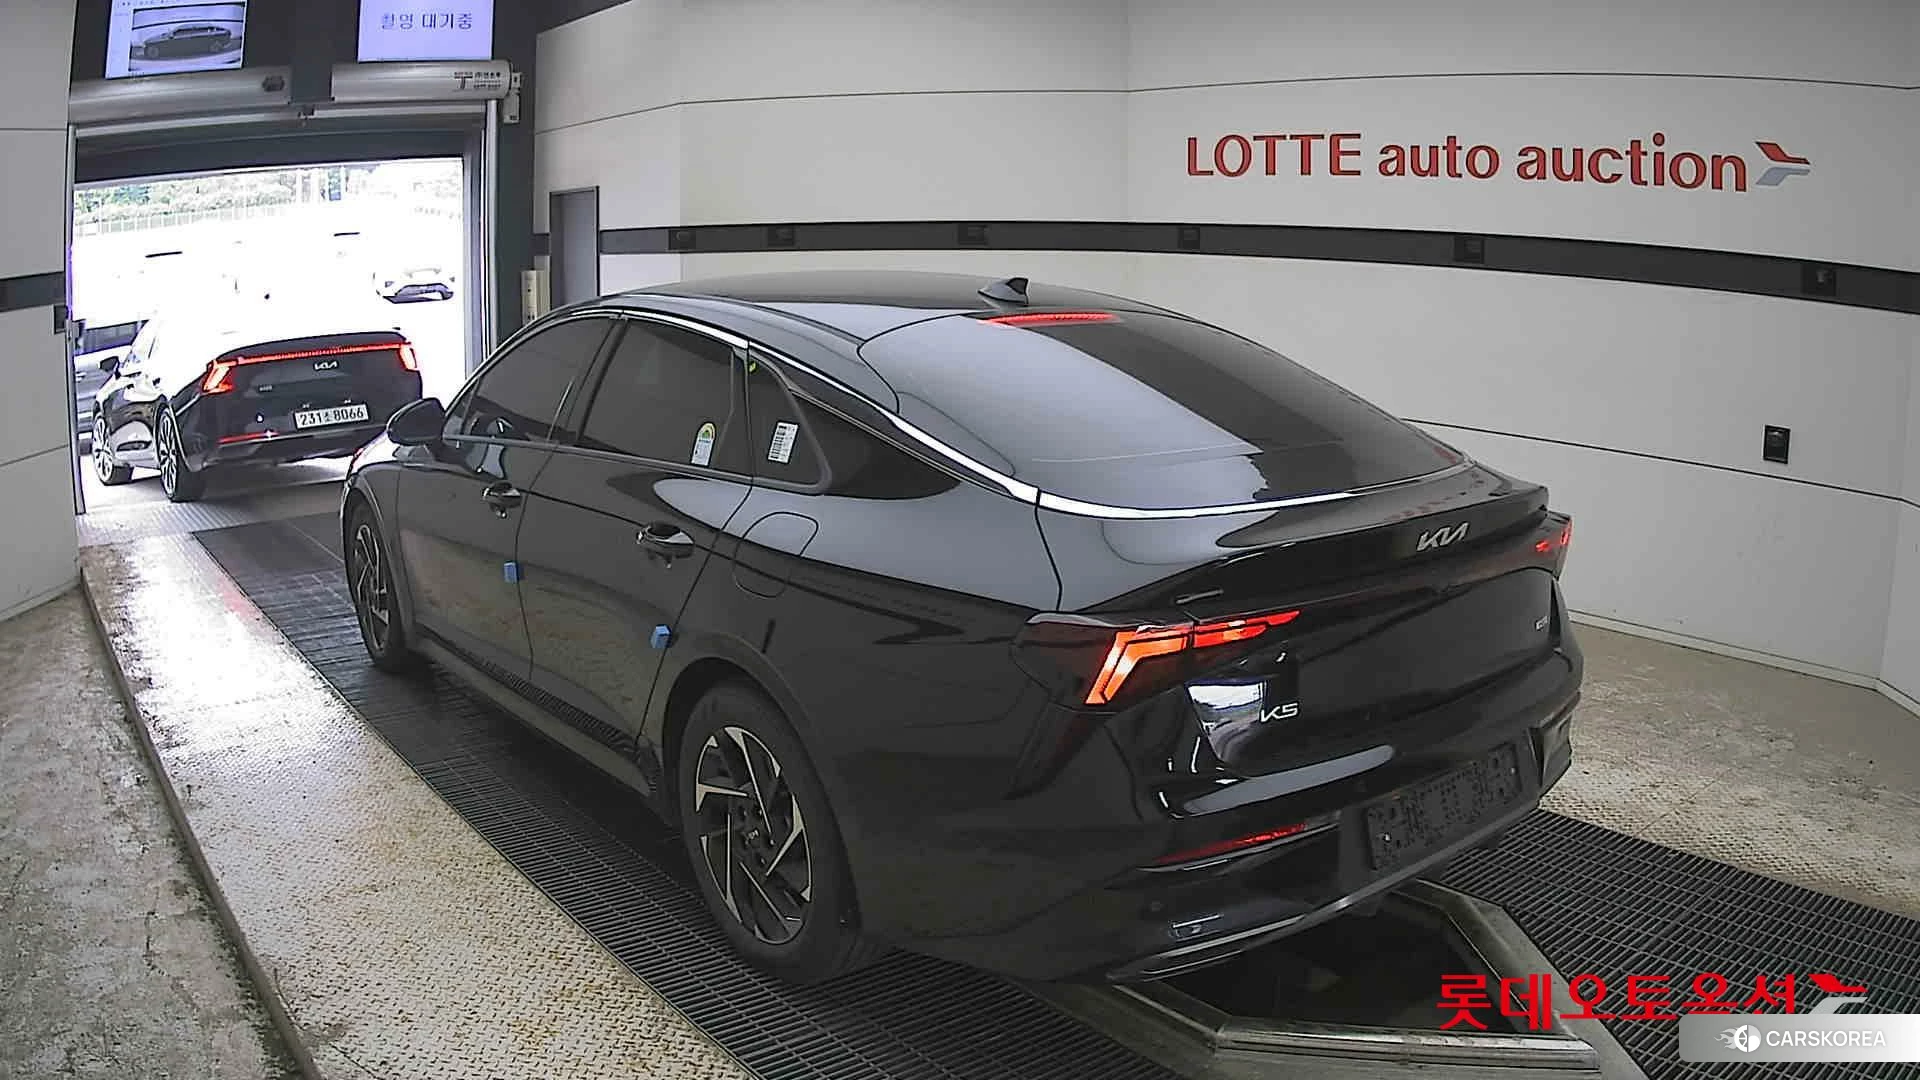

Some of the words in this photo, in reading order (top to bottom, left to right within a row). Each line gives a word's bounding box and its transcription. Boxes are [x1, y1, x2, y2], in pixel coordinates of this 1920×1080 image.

[422, 12, 473, 30] 대기중
[1186, 133, 1361, 177] LOTTE
[1378, 135, 1500, 179] auto
[1516, 132, 1747, 192] auction
[1416, 522, 1469, 551] KIA
[1260, 702, 1299, 723] K5
